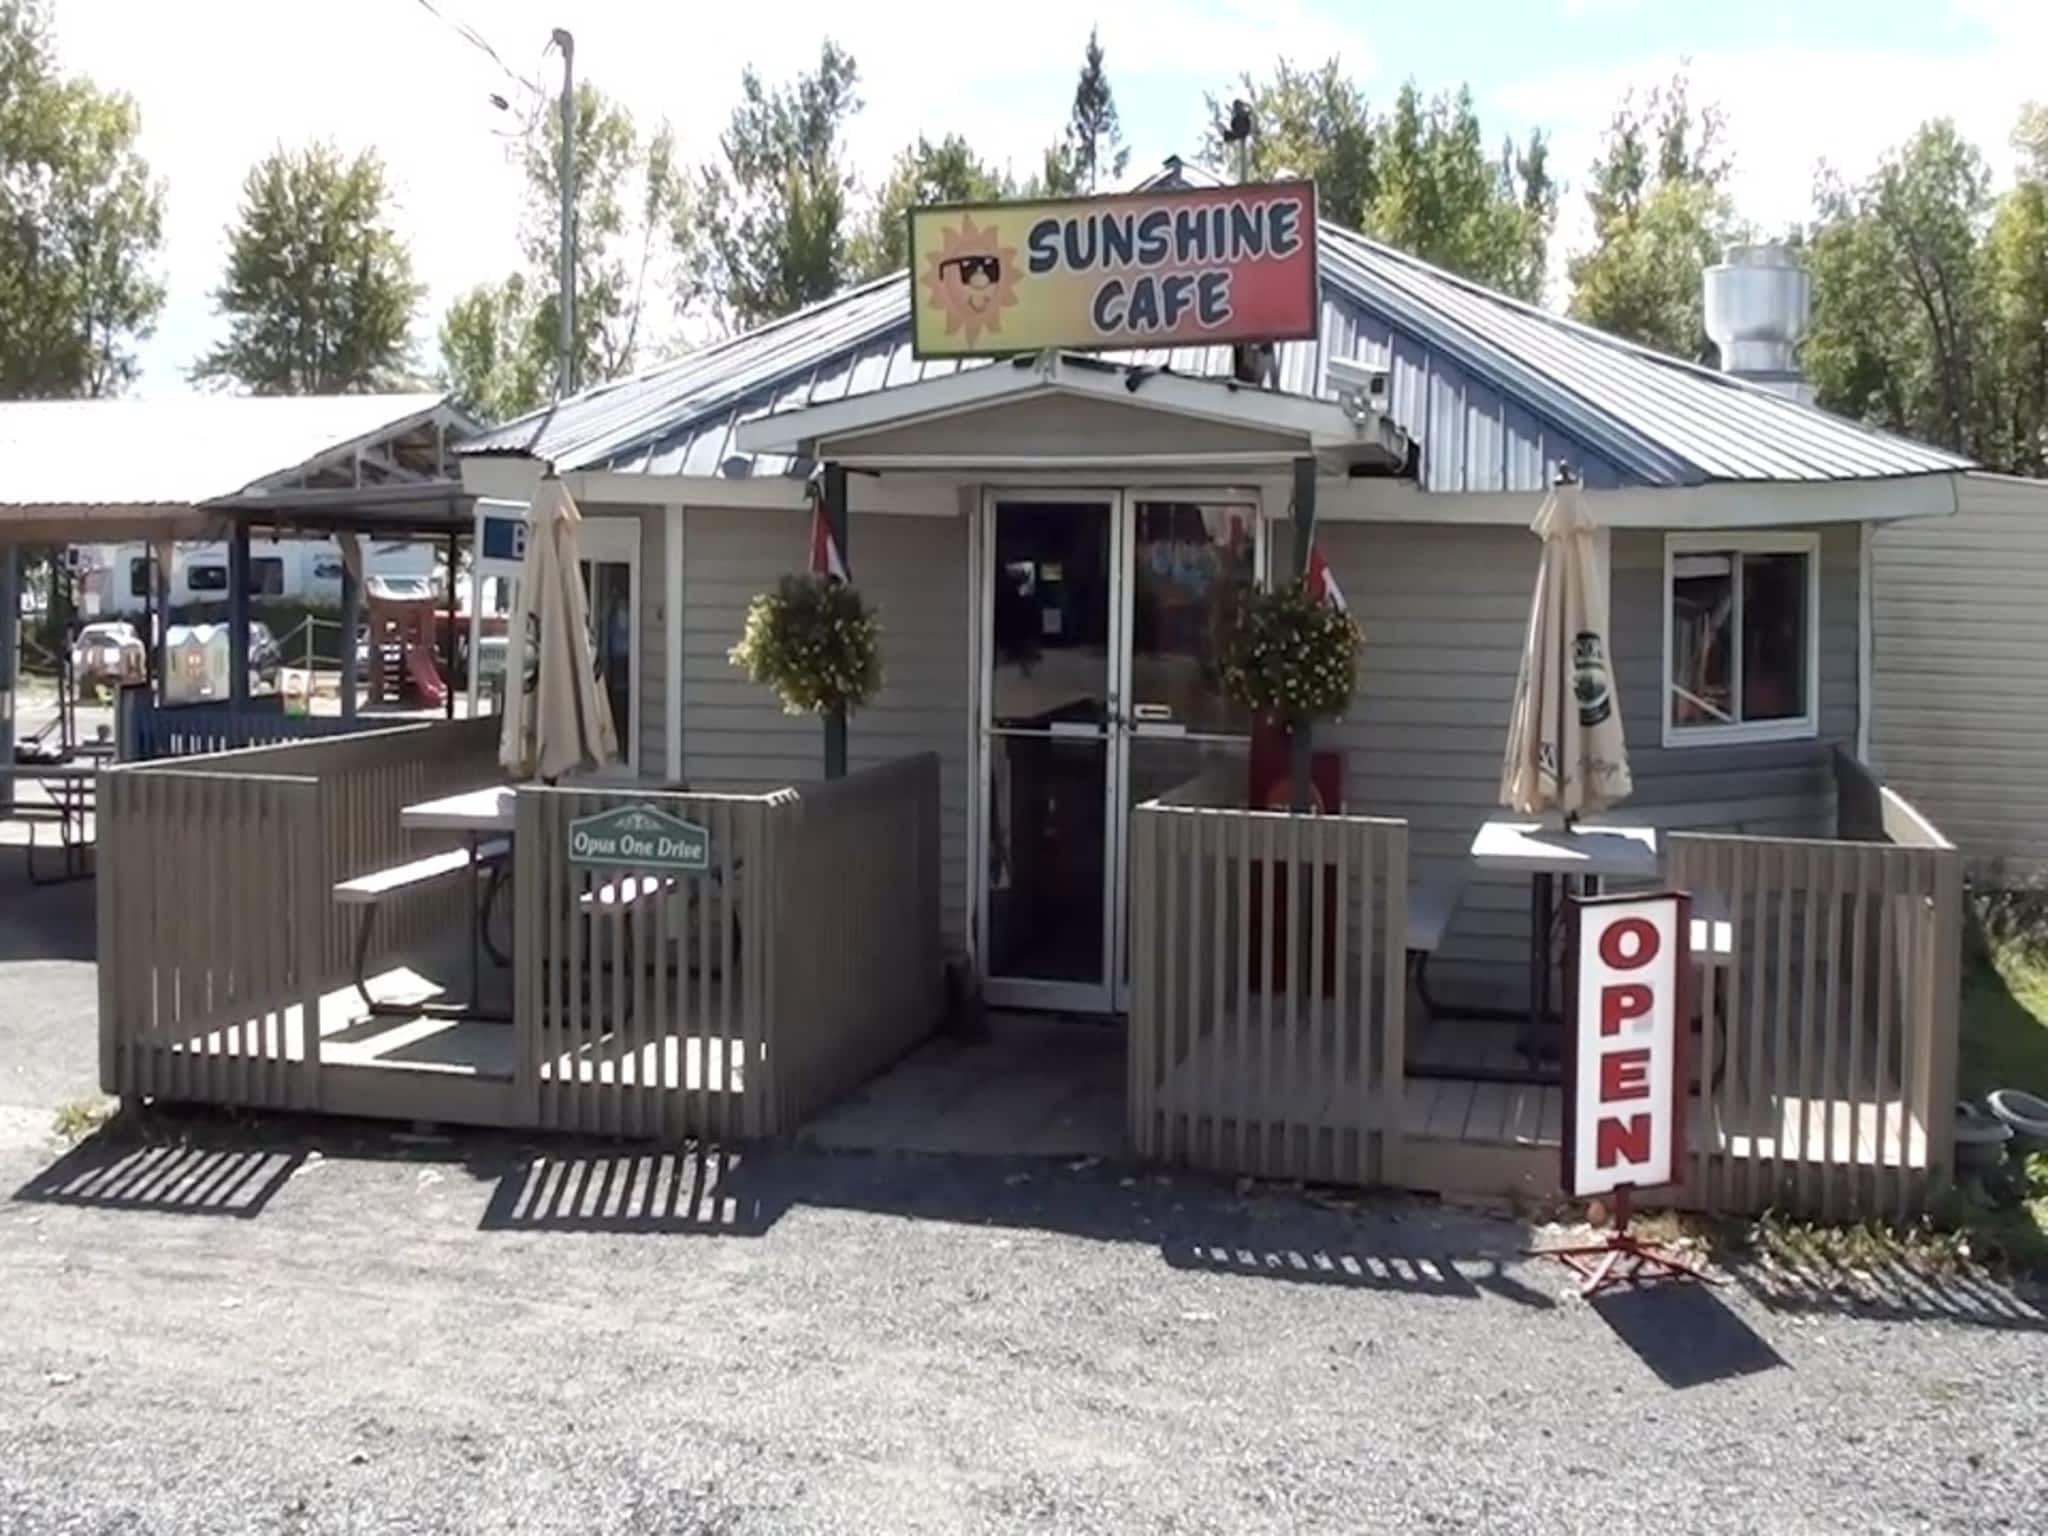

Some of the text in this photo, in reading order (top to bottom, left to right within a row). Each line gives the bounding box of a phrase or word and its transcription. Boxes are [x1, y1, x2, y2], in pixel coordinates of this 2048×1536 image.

[1027, 199, 1300, 274] SUNSHINE
[1093, 270, 1232, 333] CAFE
[574, 831, 702, 859] Opus One Drive
[1596, 916, 1662, 1170] OPEN
